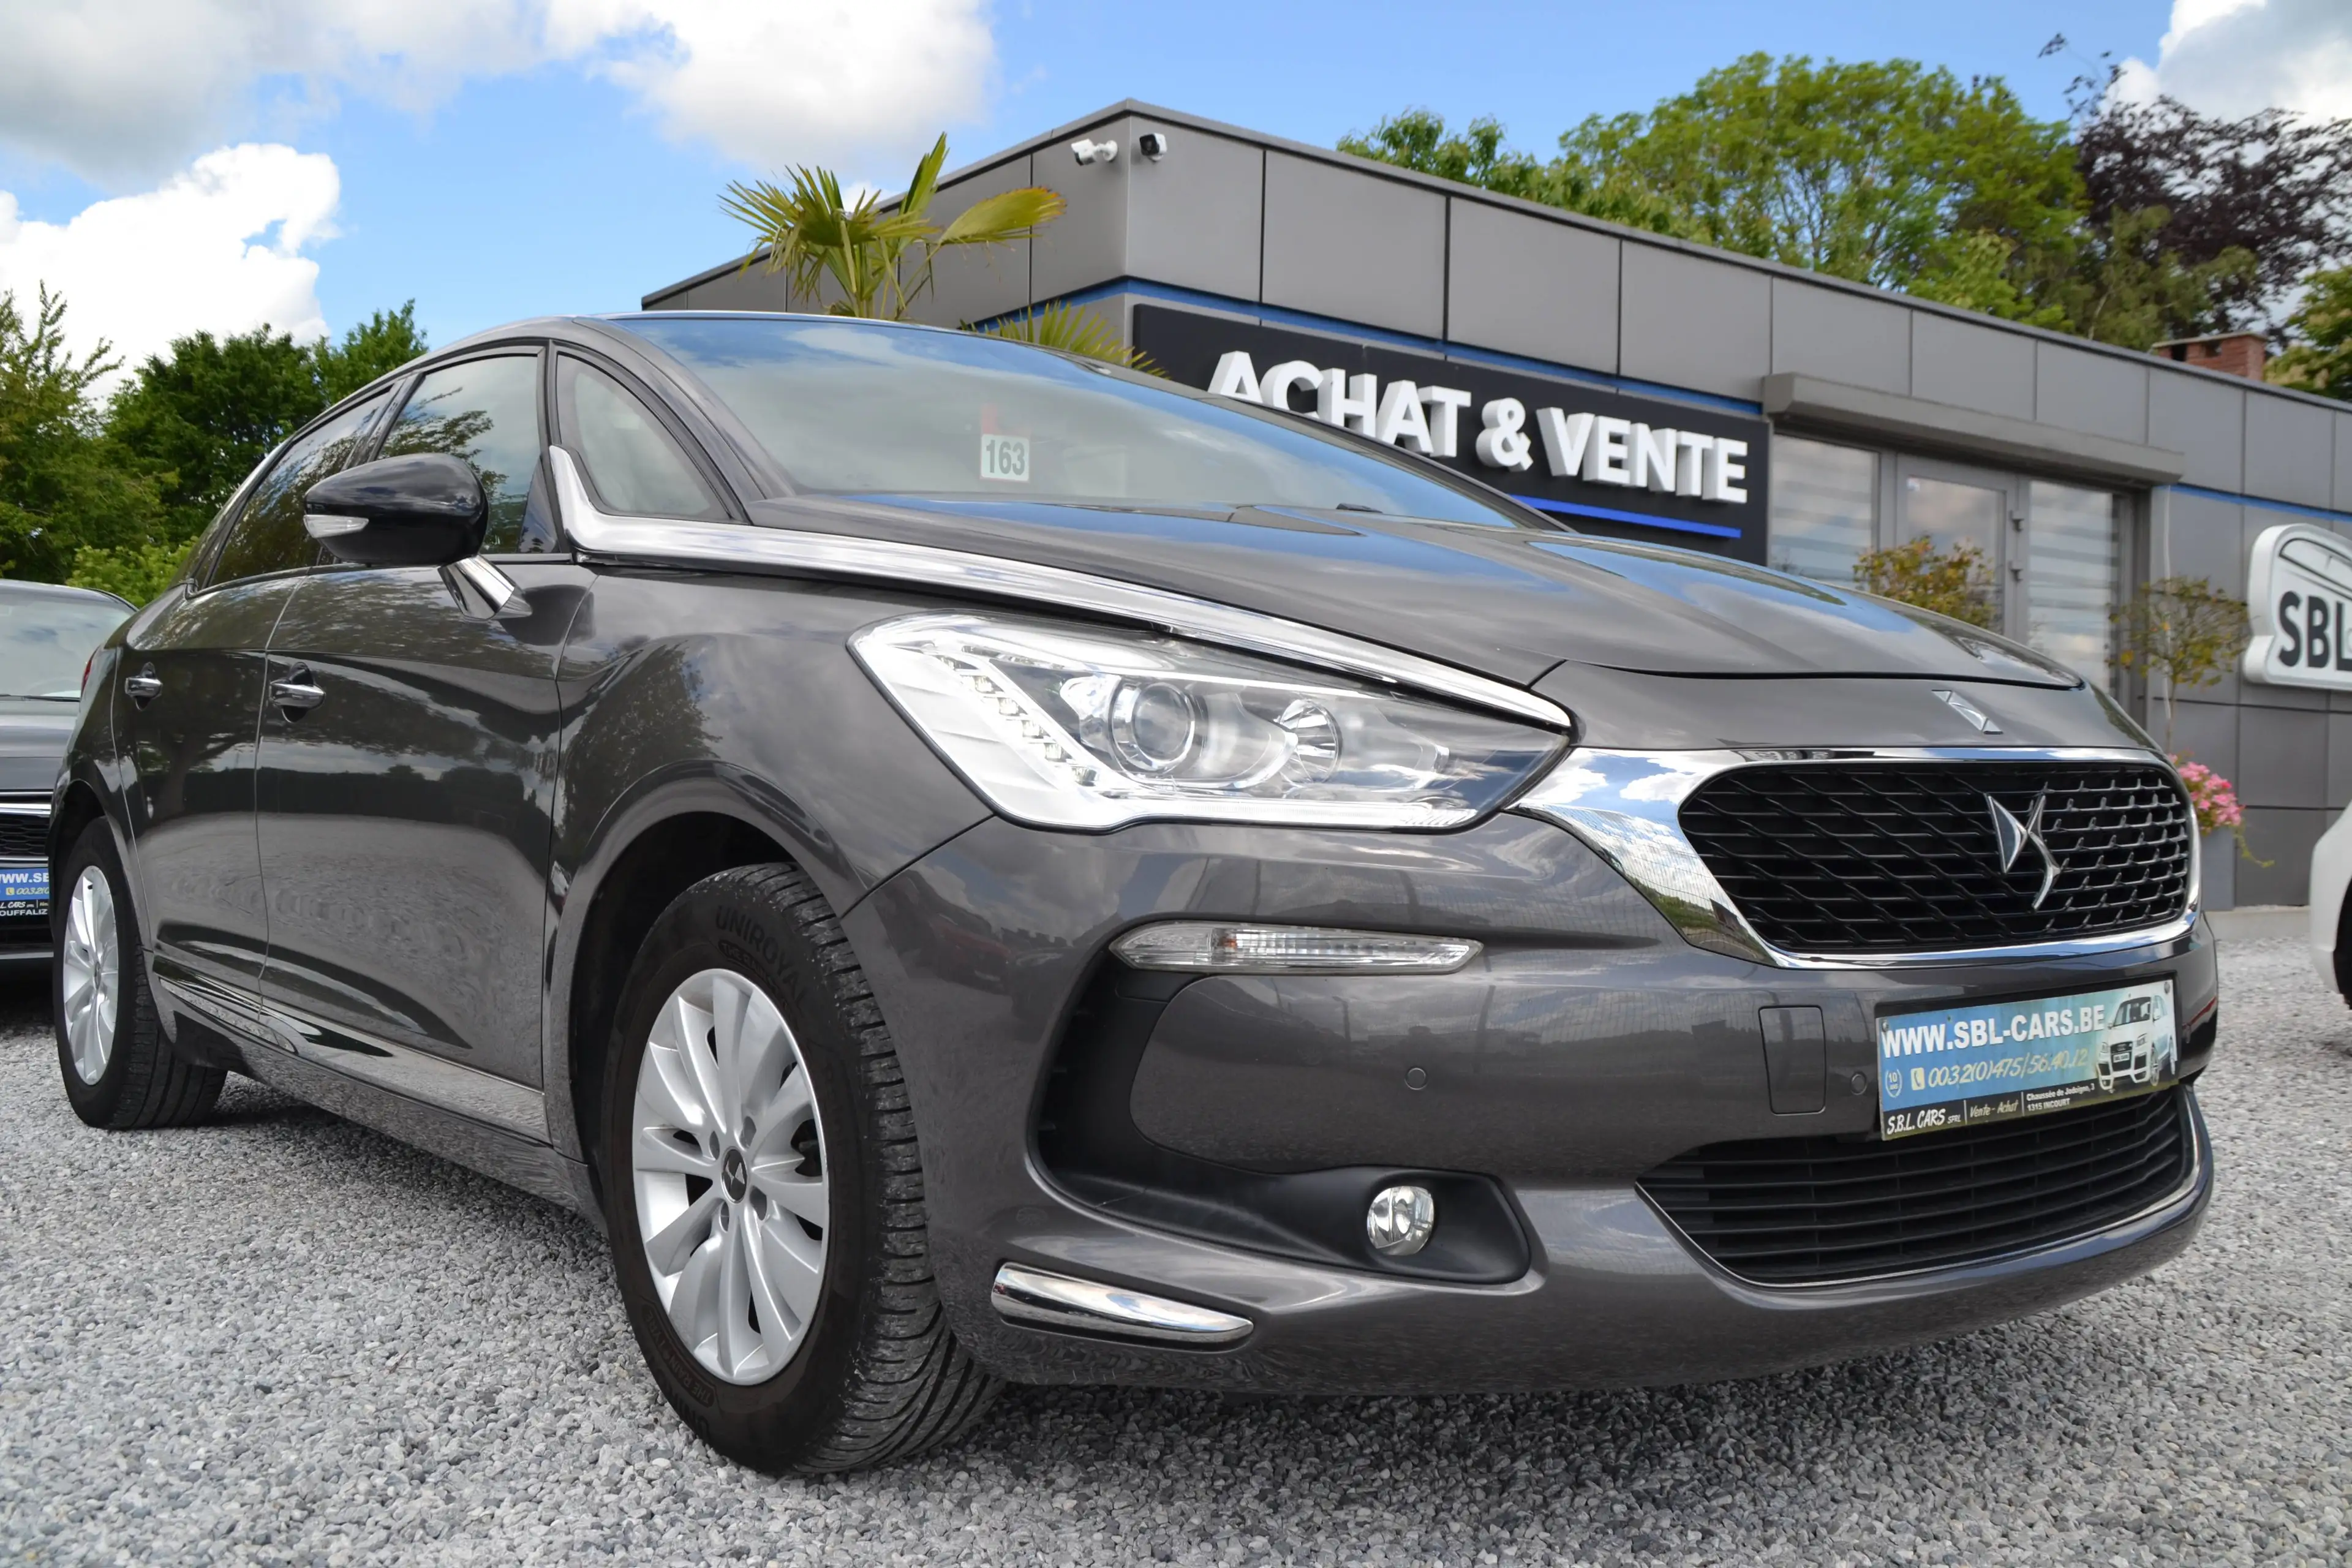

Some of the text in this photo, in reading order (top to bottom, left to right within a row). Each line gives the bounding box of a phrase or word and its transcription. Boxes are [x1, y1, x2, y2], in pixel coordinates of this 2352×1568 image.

[1208, 351, 1747, 503] ACHAT & VENTE
[986, 439, 1025, 476] 163
[2278, 590, 2352, 671] SBL
[1881, 1005, 2105, 1058] WWW.SBL-CARS.BE
[1887, 1112, 1915, 1135] S.B.L.
[1917, 1108, 1946, 1128] CARS
[1970, 1104, 1991, 1118] Vente
[2027, 1102, 2043, 1112] 1315
